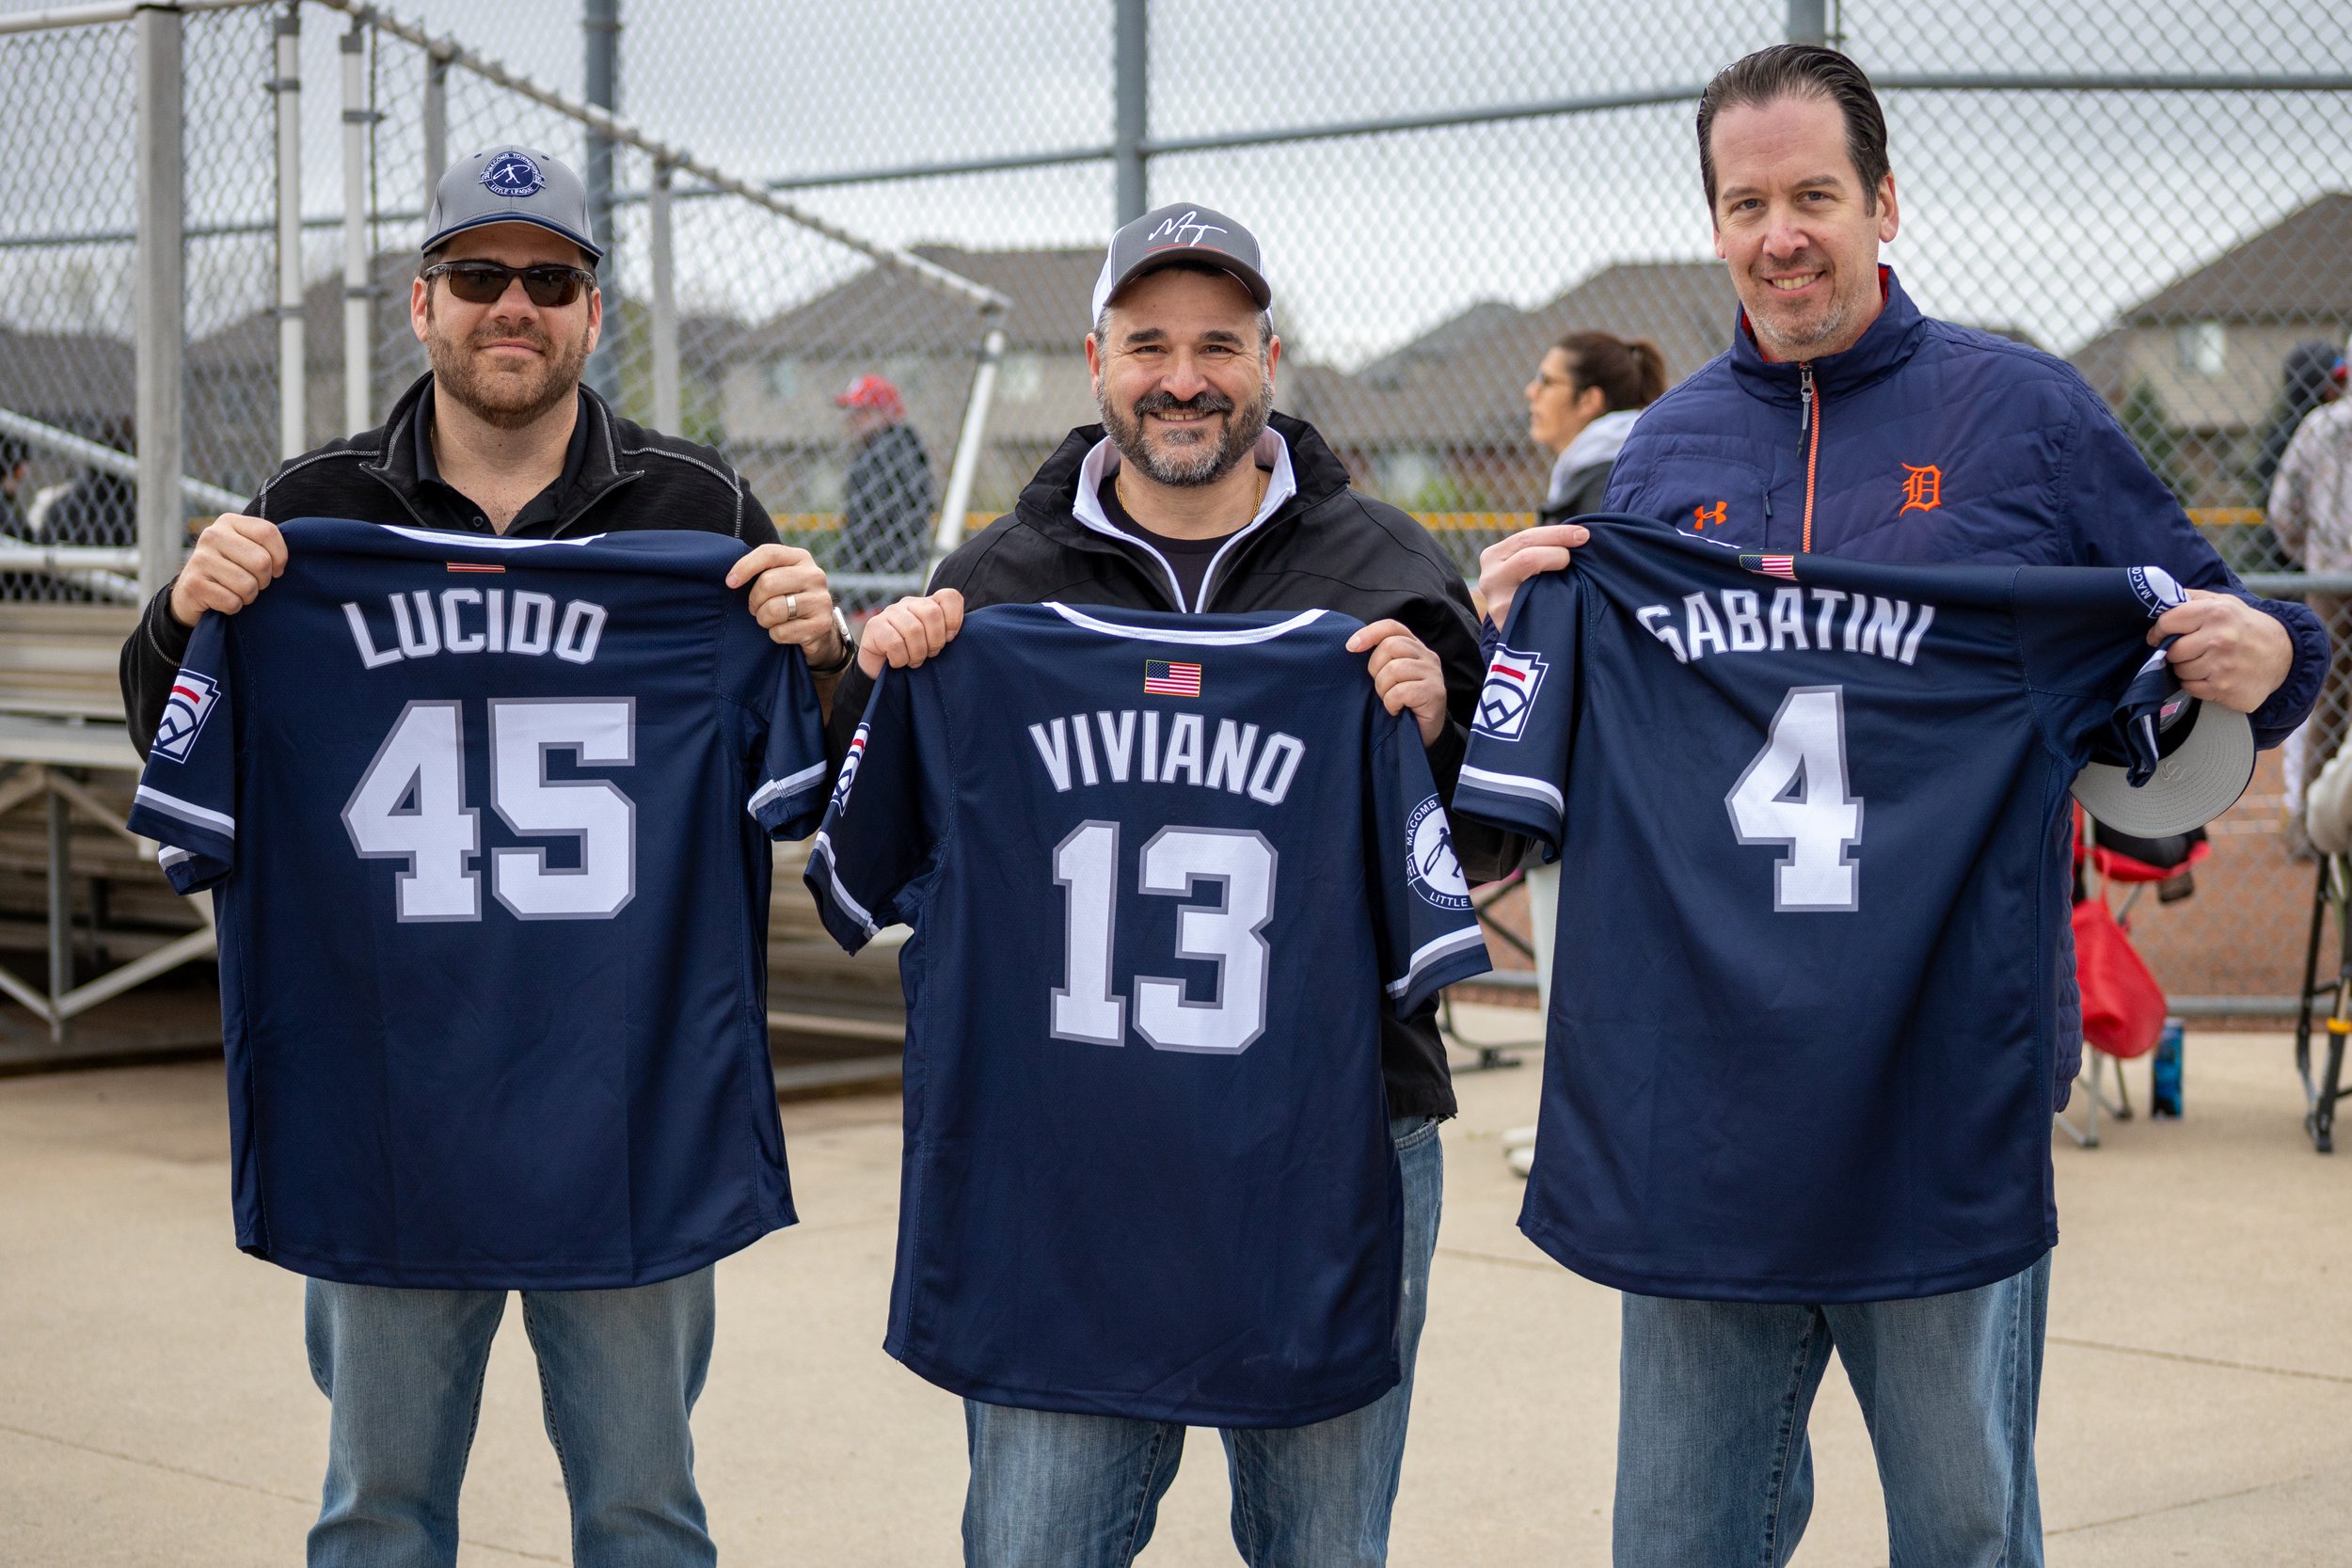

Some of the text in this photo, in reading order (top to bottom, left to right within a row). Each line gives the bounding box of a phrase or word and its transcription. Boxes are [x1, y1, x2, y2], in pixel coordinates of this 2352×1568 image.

[487, 152, 509, 170] MACOMB
[491, 184, 509, 194] LITTLE
[2131, 566, 2153, 599] MACO
[342, 588, 609, 670] LUCIDO
[1028, 710, 1305, 806] VIVIANO
[341, 696, 636, 923] 45
[1406, 800, 1438, 846] MACOMB
[1724, 685, 1864, 912] 4
[1429, 892, 1469, 908] LITTLE
[1050, 819, 1279, 1053] 13
